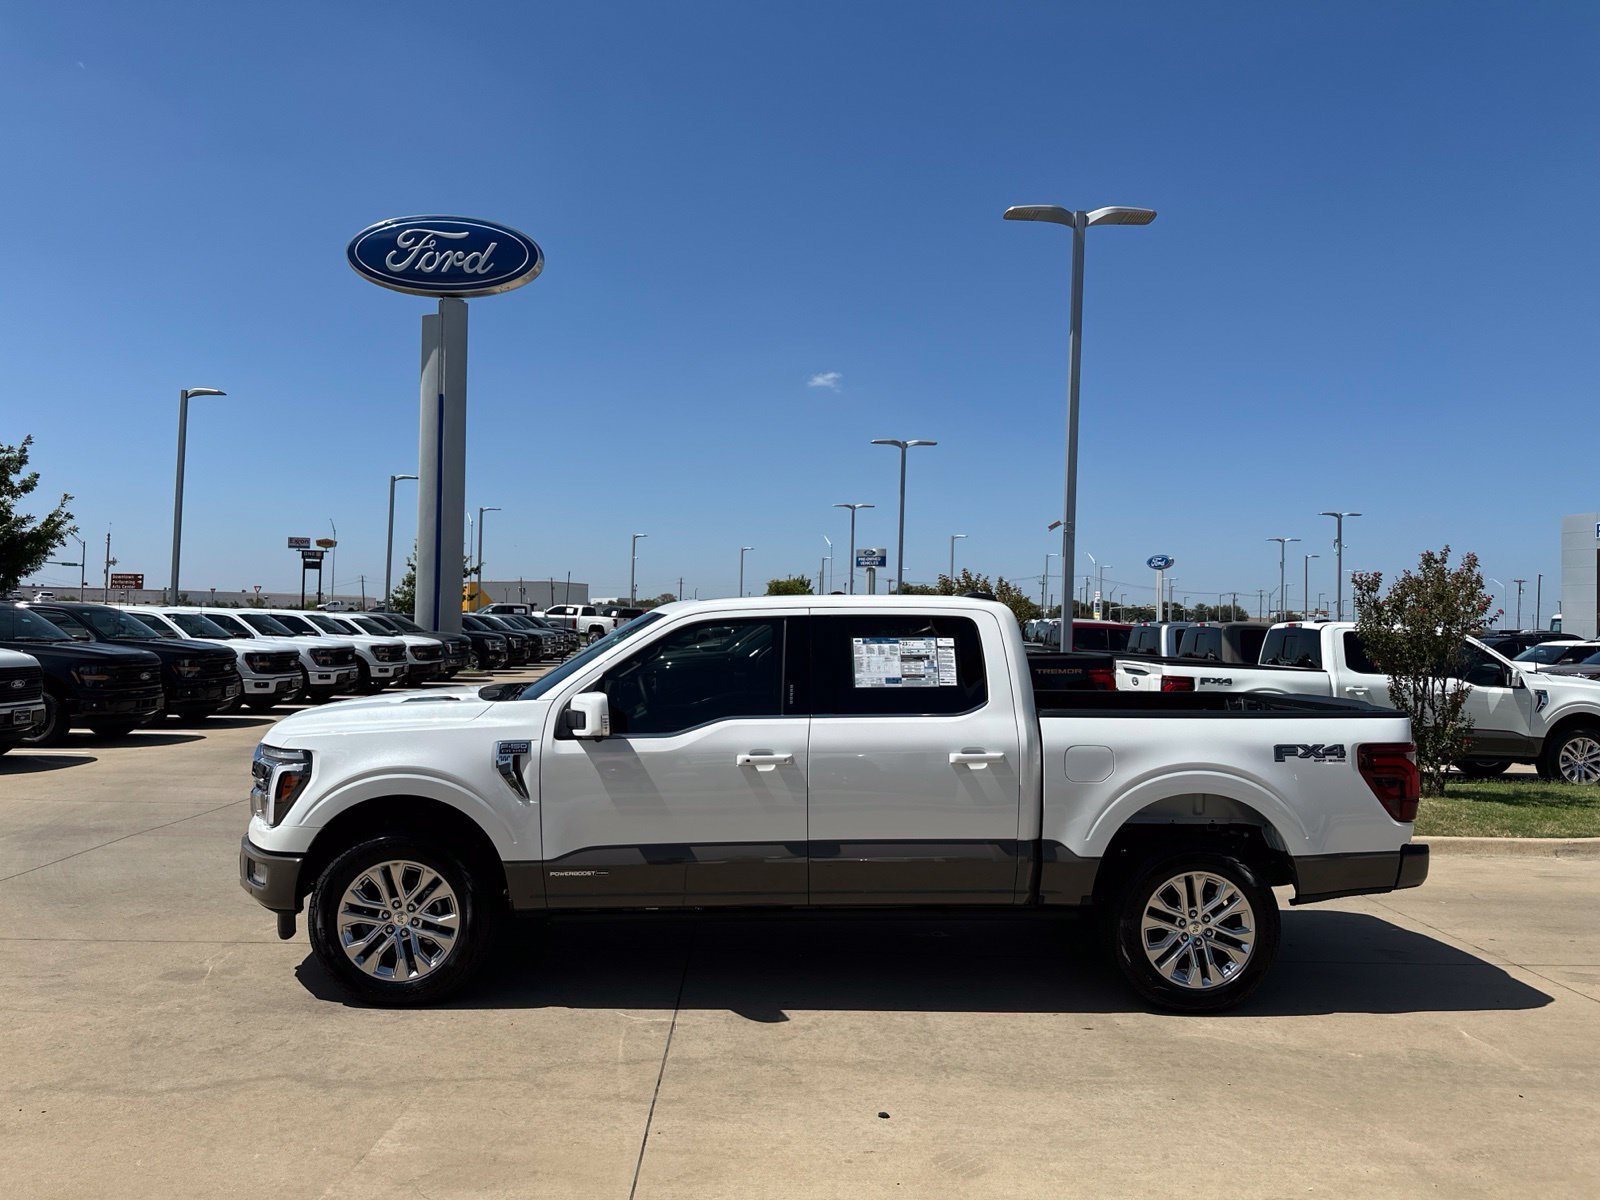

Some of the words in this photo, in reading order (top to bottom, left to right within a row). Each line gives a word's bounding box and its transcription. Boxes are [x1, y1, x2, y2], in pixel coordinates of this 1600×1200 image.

[385, 228, 498, 275] Ford
[289, 538, 309, 546] Exxon
[1151, 557, 1167, 567] Ford
[1200, 677, 1233, 686] FX4
[1273, 744, 1346, 762] FX4
